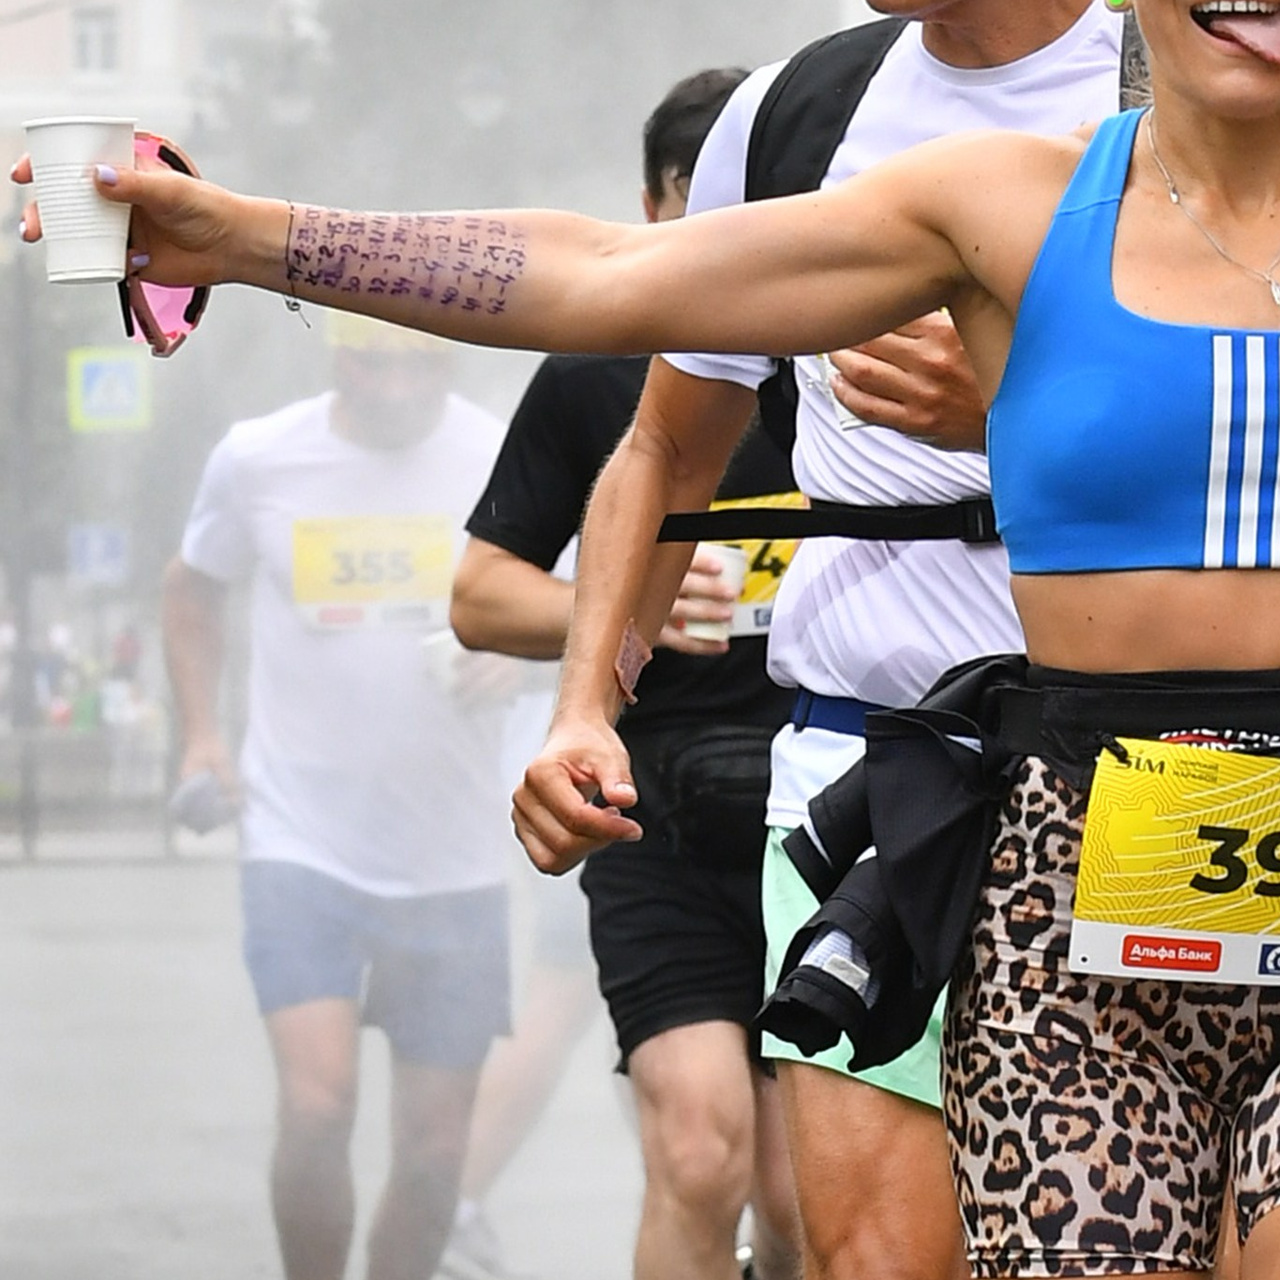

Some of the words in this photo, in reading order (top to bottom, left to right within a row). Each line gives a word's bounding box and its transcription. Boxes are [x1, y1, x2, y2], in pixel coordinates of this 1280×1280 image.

[330, 549, 415, 586] 355
[1128, 942, 1176, 962] Альфа
[1178, 946, 1213, 962] Банк
